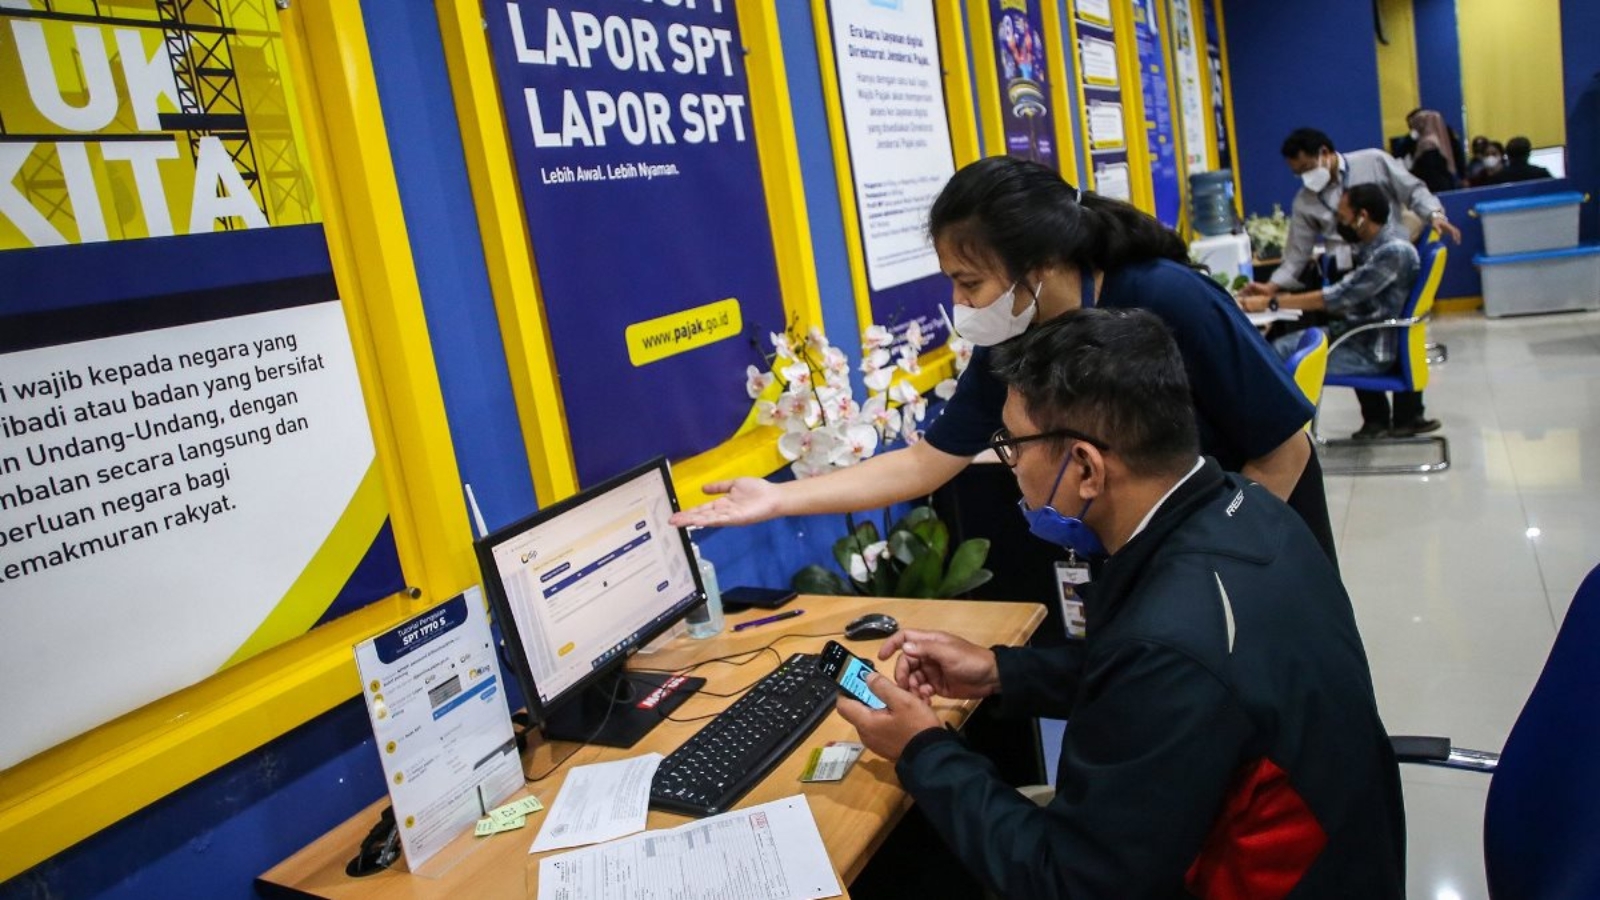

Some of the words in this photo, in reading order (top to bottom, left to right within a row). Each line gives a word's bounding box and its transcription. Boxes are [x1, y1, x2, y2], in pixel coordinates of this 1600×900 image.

[506, 2, 665, 72] LAPOR
[667, 23, 733, 77] SPT
[524, 87, 676, 148] LAPOR
[680, 93, 746, 143] SPT
[541, 167, 575, 184] Lebih
[577, 165, 606, 182] Awal.
[607, 163, 638, 180] Lebih
[638, 162, 680, 181] Nyaman.
[642, 312, 729, 349] www.pajak.go.id
[0, 406, 66, 438] ibadi
[74, 399, 126, 422] atau
[132, 384, 199, 409] badan
[204, 372, 251, 398] yang
[255, 355, 324, 382] bersifat
[12, 370, 82, 399] wajib
[88, 355, 172, 386] kepada
[179, 344, 249, 368] negara
[253, 335, 296, 358] yang
[26, 410, 224, 466] Undang-Undang,
[230, 392, 297, 418] dengan
[97, 453, 174, 483] secara
[178, 427, 271, 461] langsung
[276, 418, 308, 435] dan
[102, 482, 181, 516] negara
[186, 463, 230, 491] bagi
[0, 521, 158, 583] emakmuran
[164, 496, 235, 530] rakyat.
[403, 630, 419, 645] SPT
[420, 621, 439, 636] 1770
[440, 616, 446, 626] S
